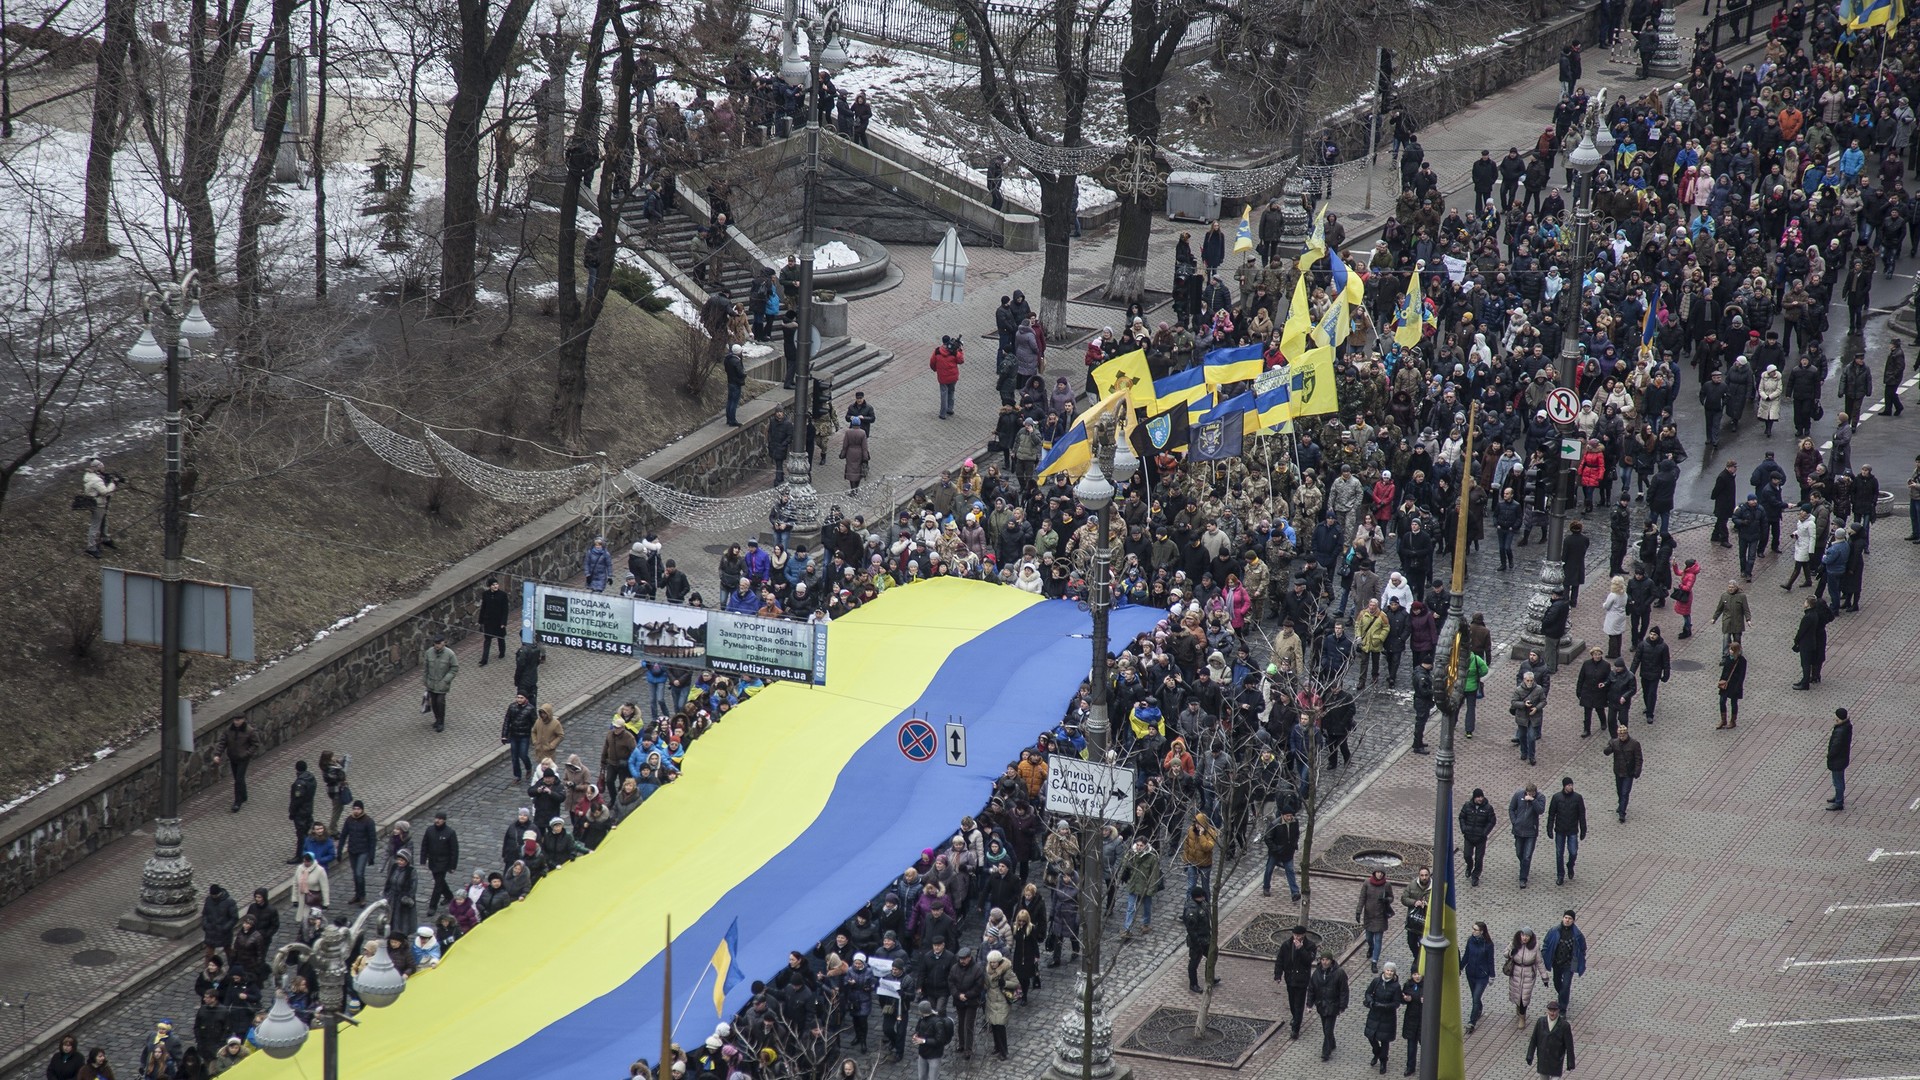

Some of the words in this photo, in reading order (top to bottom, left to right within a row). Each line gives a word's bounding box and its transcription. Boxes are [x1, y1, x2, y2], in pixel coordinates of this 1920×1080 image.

[546, 604, 566, 613] LETIZIA
[570, 597, 611, 610] ПРОДАЖА
[570, 607, 607, 618] КВАРТИР
[608, 611, 614, 619] И
[542, 622, 565, 632] 100%
[567, 627, 619, 640] готовность
[570, 617, 619, 629] КОТТЕДЖЕЙ
[734, 621, 765, 632] КУРОРТ
[768, 626, 793, 636] ШАЯН
[541, 635, 562, 644] тел.
[565, 636, 583, 647] 068
[586, 640, 603, 650] 154
[605, 643, 617, 652] 54
[620, 645, 632, 654] 54
[719, 629, 772, 643] Закарпатская
[775, 638, 807, 649] область
[723, 639, 803, 657] Румыно-Венгерская
[816, 633, 826, 678] 482-0808
[747, 653, 779, 664] граница
[712, 659, 807, 681] www.letizia.net.ua
